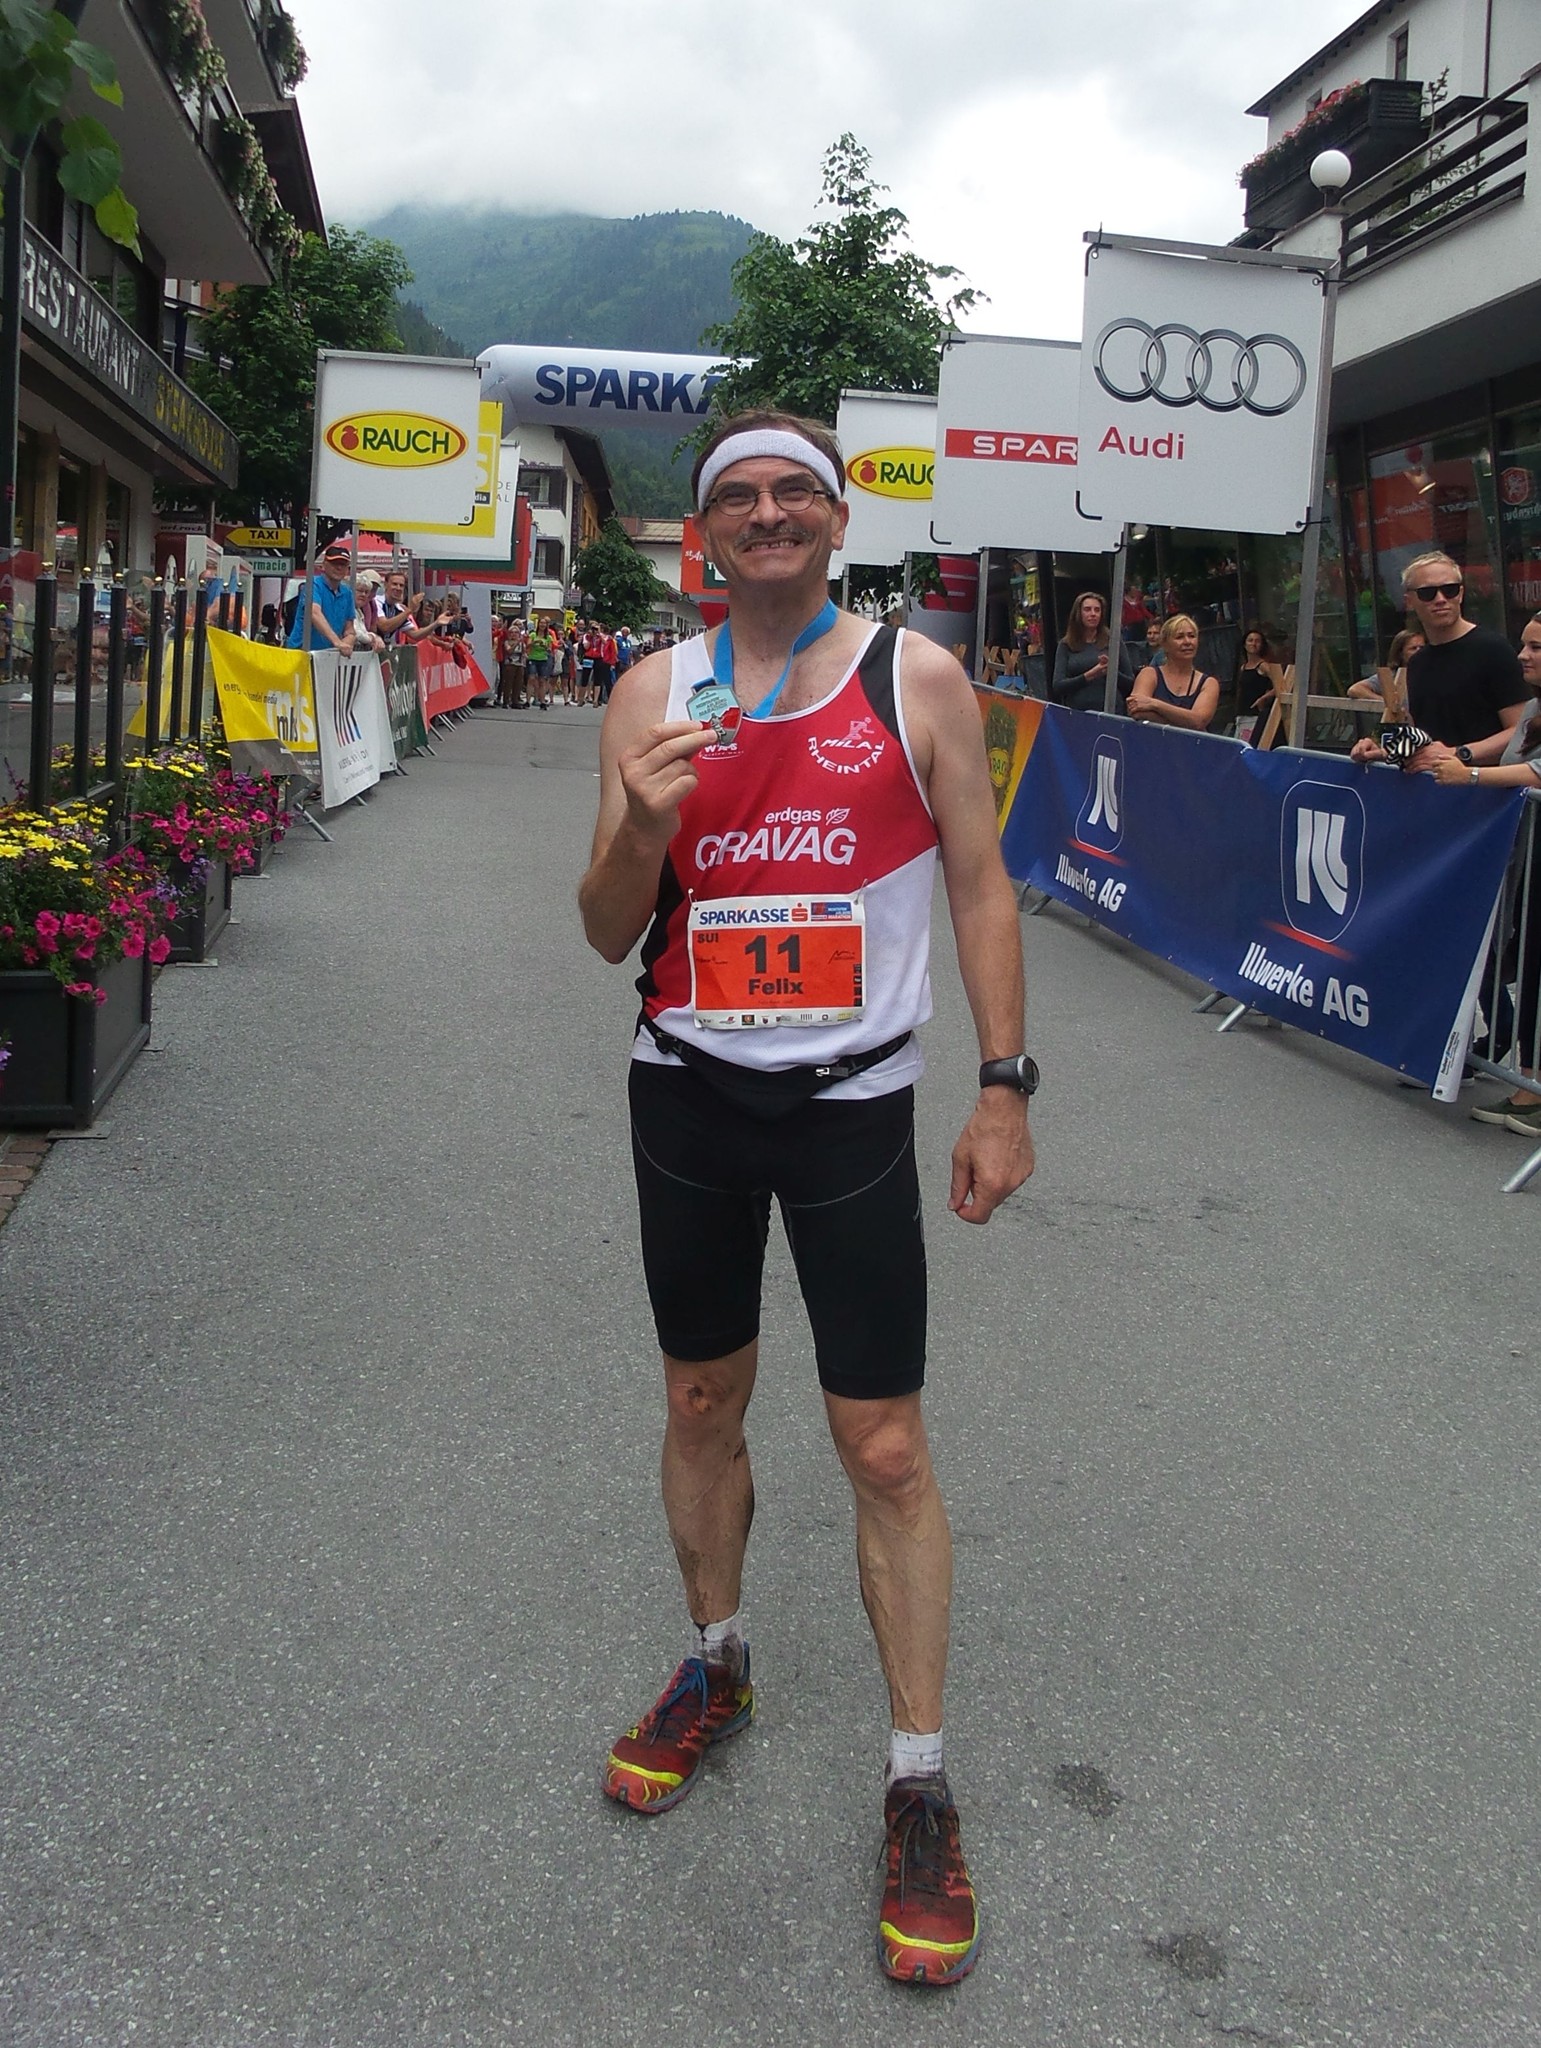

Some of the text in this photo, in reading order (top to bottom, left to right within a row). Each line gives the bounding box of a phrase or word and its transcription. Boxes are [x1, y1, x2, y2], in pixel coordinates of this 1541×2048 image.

[21, 239, 140, 395] RESTAURANT
[362, 426, 450, 456] RAUCH
[972, 433, 1079, 462] SPAR
[1097, 426, 1185, 461] Audi
[249, 529, 279, 541] TAXI
[808, 737, 885, 775] RHEINTAL
[820, 739, 873, 750] MILA
[764, 806, 822, 825] erdgas
[695, 826, 858, 872] GRAVAG
[1055, 853, 1128, 912] Illwerke AG
[699, 908, 789, 925] SPARKASSE
[697, 933, 719, 944] SUI
[744, 934, 801, 974] 11
[748, 978, 804, 995] Felix
[1237, 941, 1371, 1029] Illwerke AG
